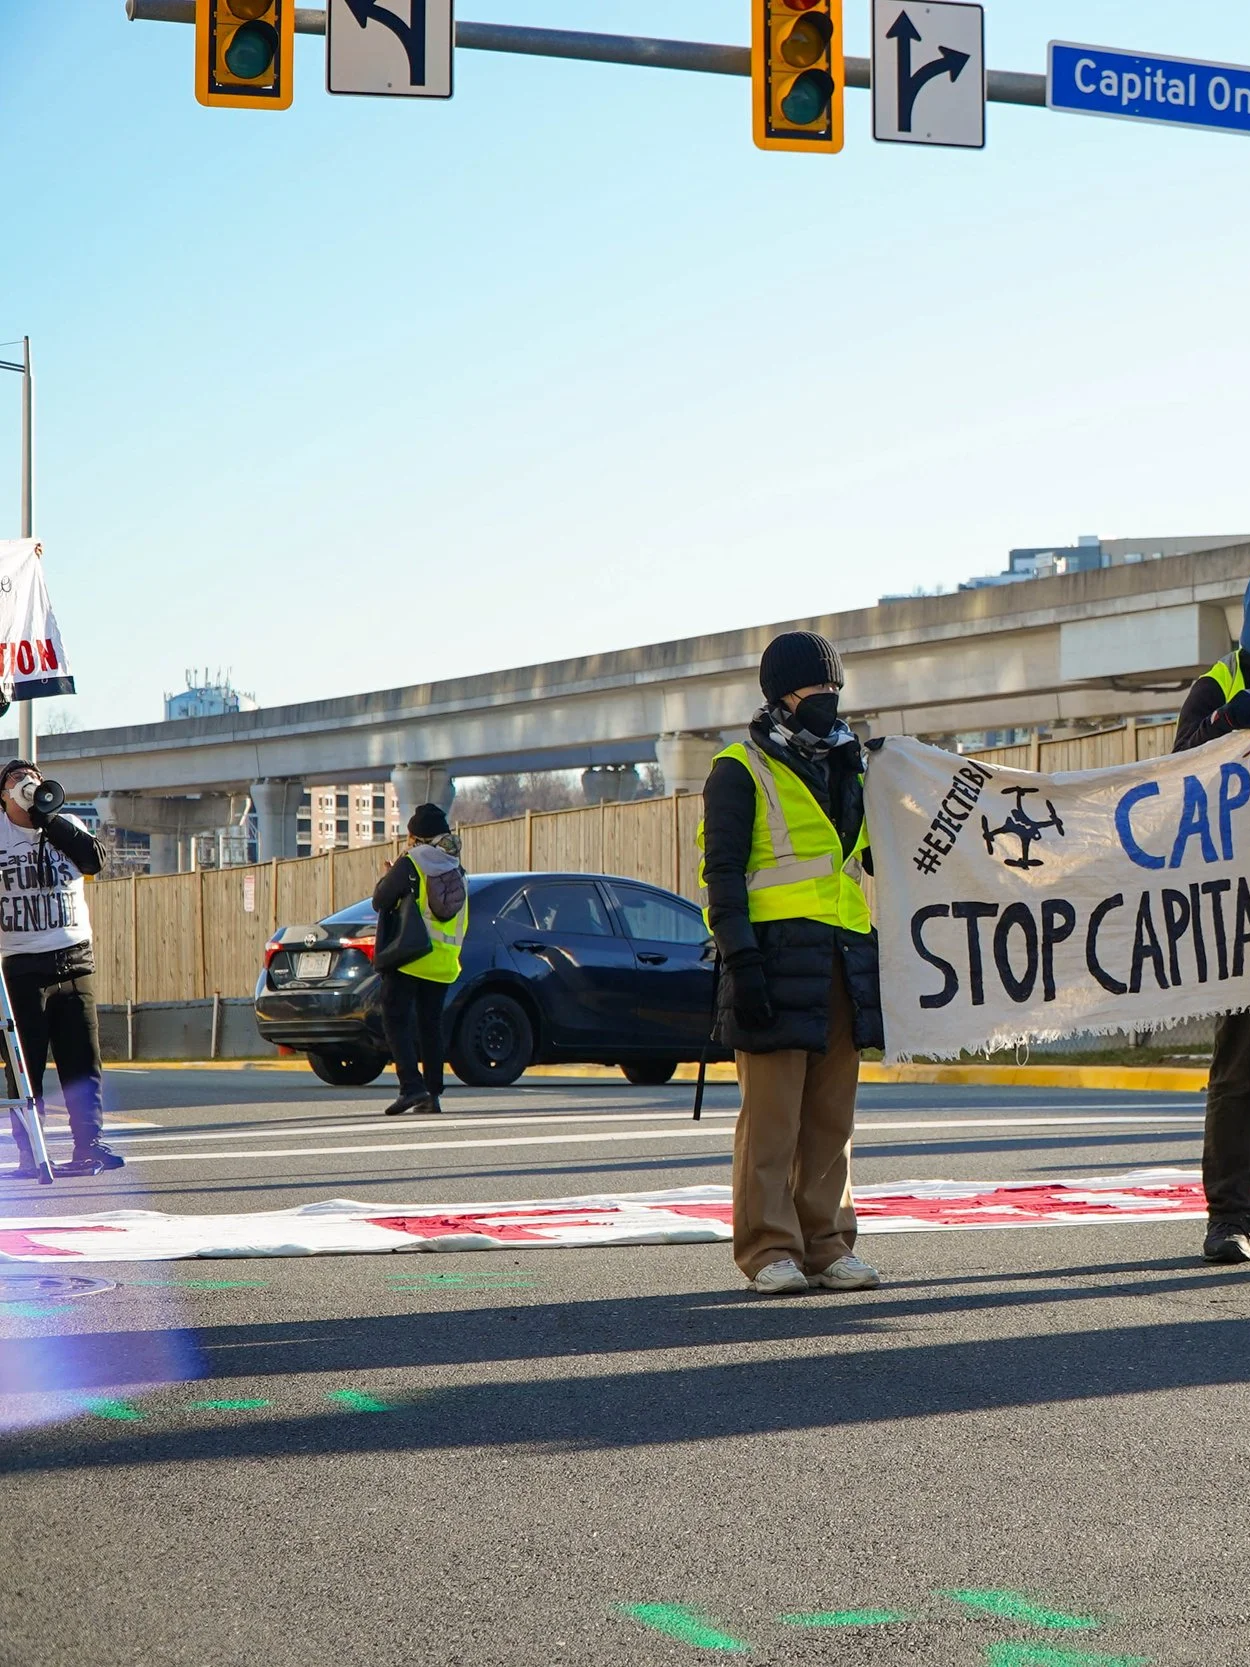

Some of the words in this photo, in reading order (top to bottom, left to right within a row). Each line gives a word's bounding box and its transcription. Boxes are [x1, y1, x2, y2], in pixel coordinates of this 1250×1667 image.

[1074, 58, 1195, 107] Capital
[0, 891, 79, 932] GENOCIDE
[911, 898, 1076, 1008] STOP
